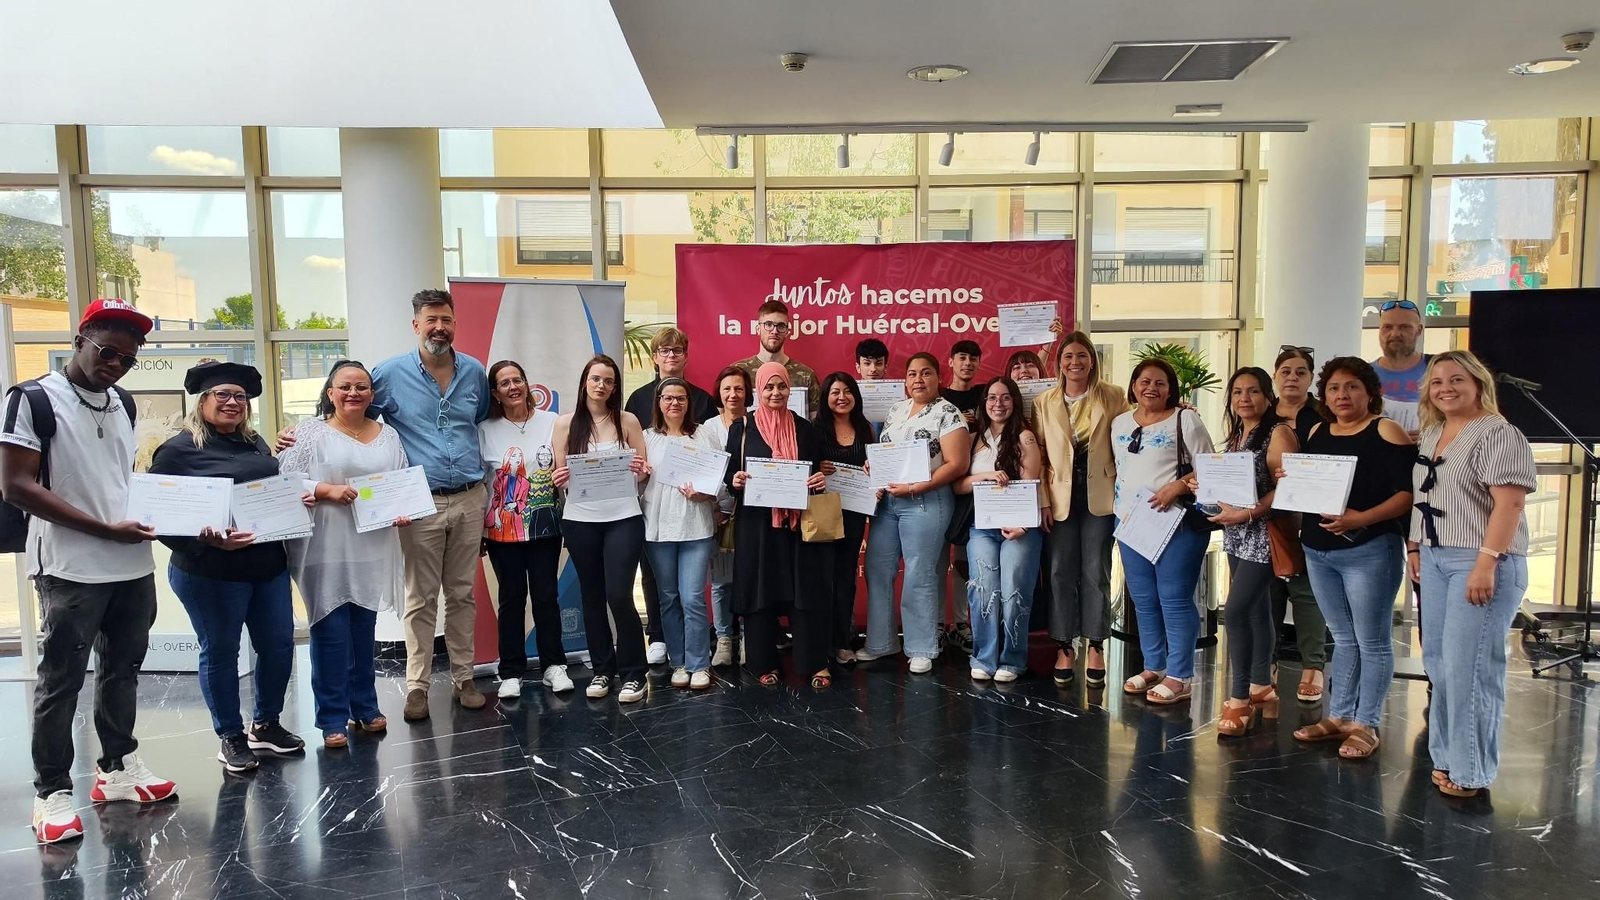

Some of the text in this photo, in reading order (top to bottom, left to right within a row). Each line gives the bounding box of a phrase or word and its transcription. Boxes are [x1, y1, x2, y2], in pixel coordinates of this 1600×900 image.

[765, 276, 984, 308] Juntos hacemos
[719, 314, 741, 335] la
[751, 313, 828, 340] jor
[836, 313, 1000, 335] Huércal-Ove
[132, 358, 173, 371] SICIÓN
